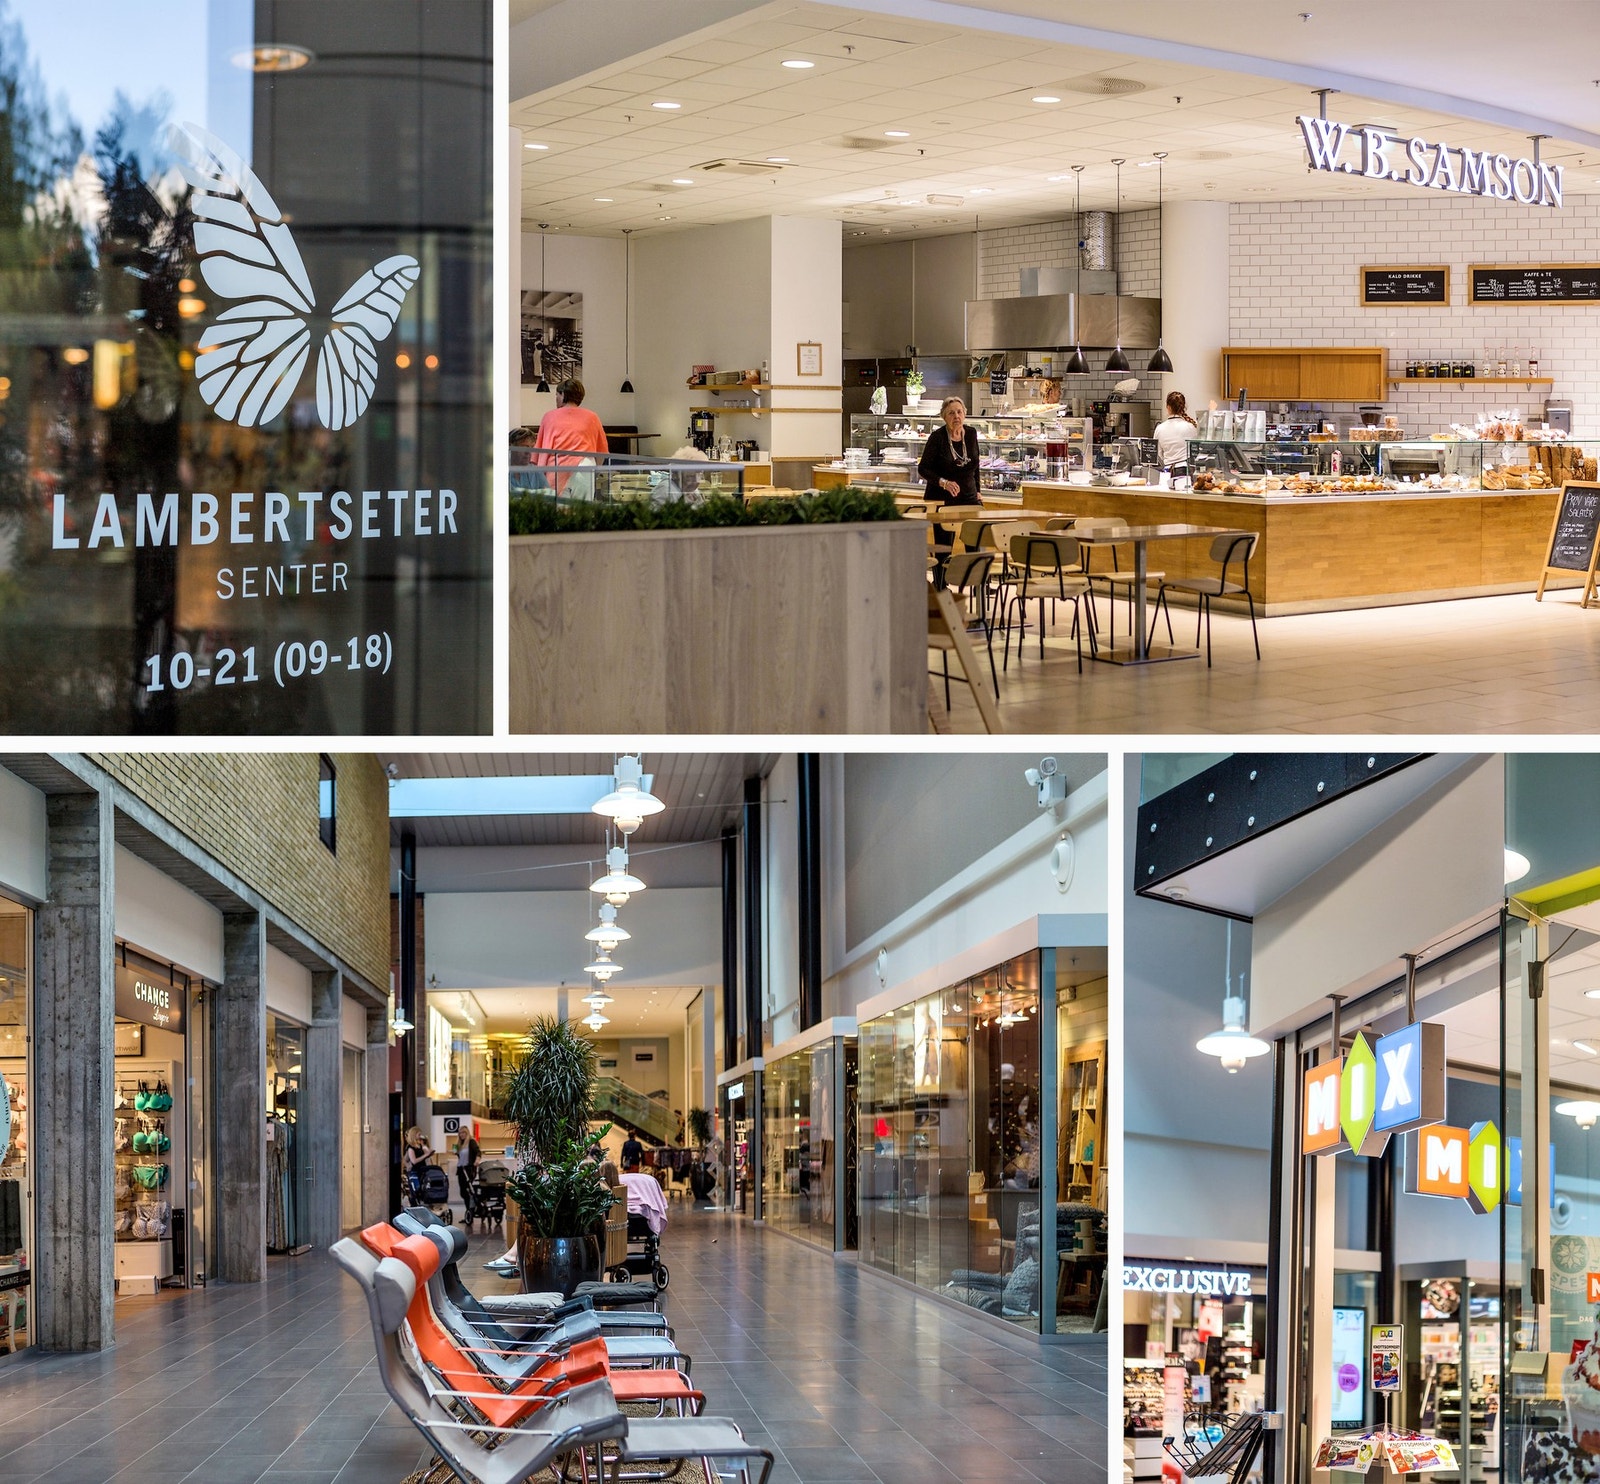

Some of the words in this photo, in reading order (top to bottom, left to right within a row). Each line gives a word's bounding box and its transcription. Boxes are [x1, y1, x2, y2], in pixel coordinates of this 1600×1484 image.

[1406, 137, 1564, 209] SAMSON
[52, 488, 459, 550] LAMBERTSETER
[216, 562, 349, 600] SENTER
[145, 646, 260, 693] 10-21
[273, 631, 393, 688] (09-18)
[135, 981, 169, 1009] CHANGE
[1307, 1042, 1412, 1136] MIX
[1123, 1266, 1252, 1296] EXCLUSIVE
